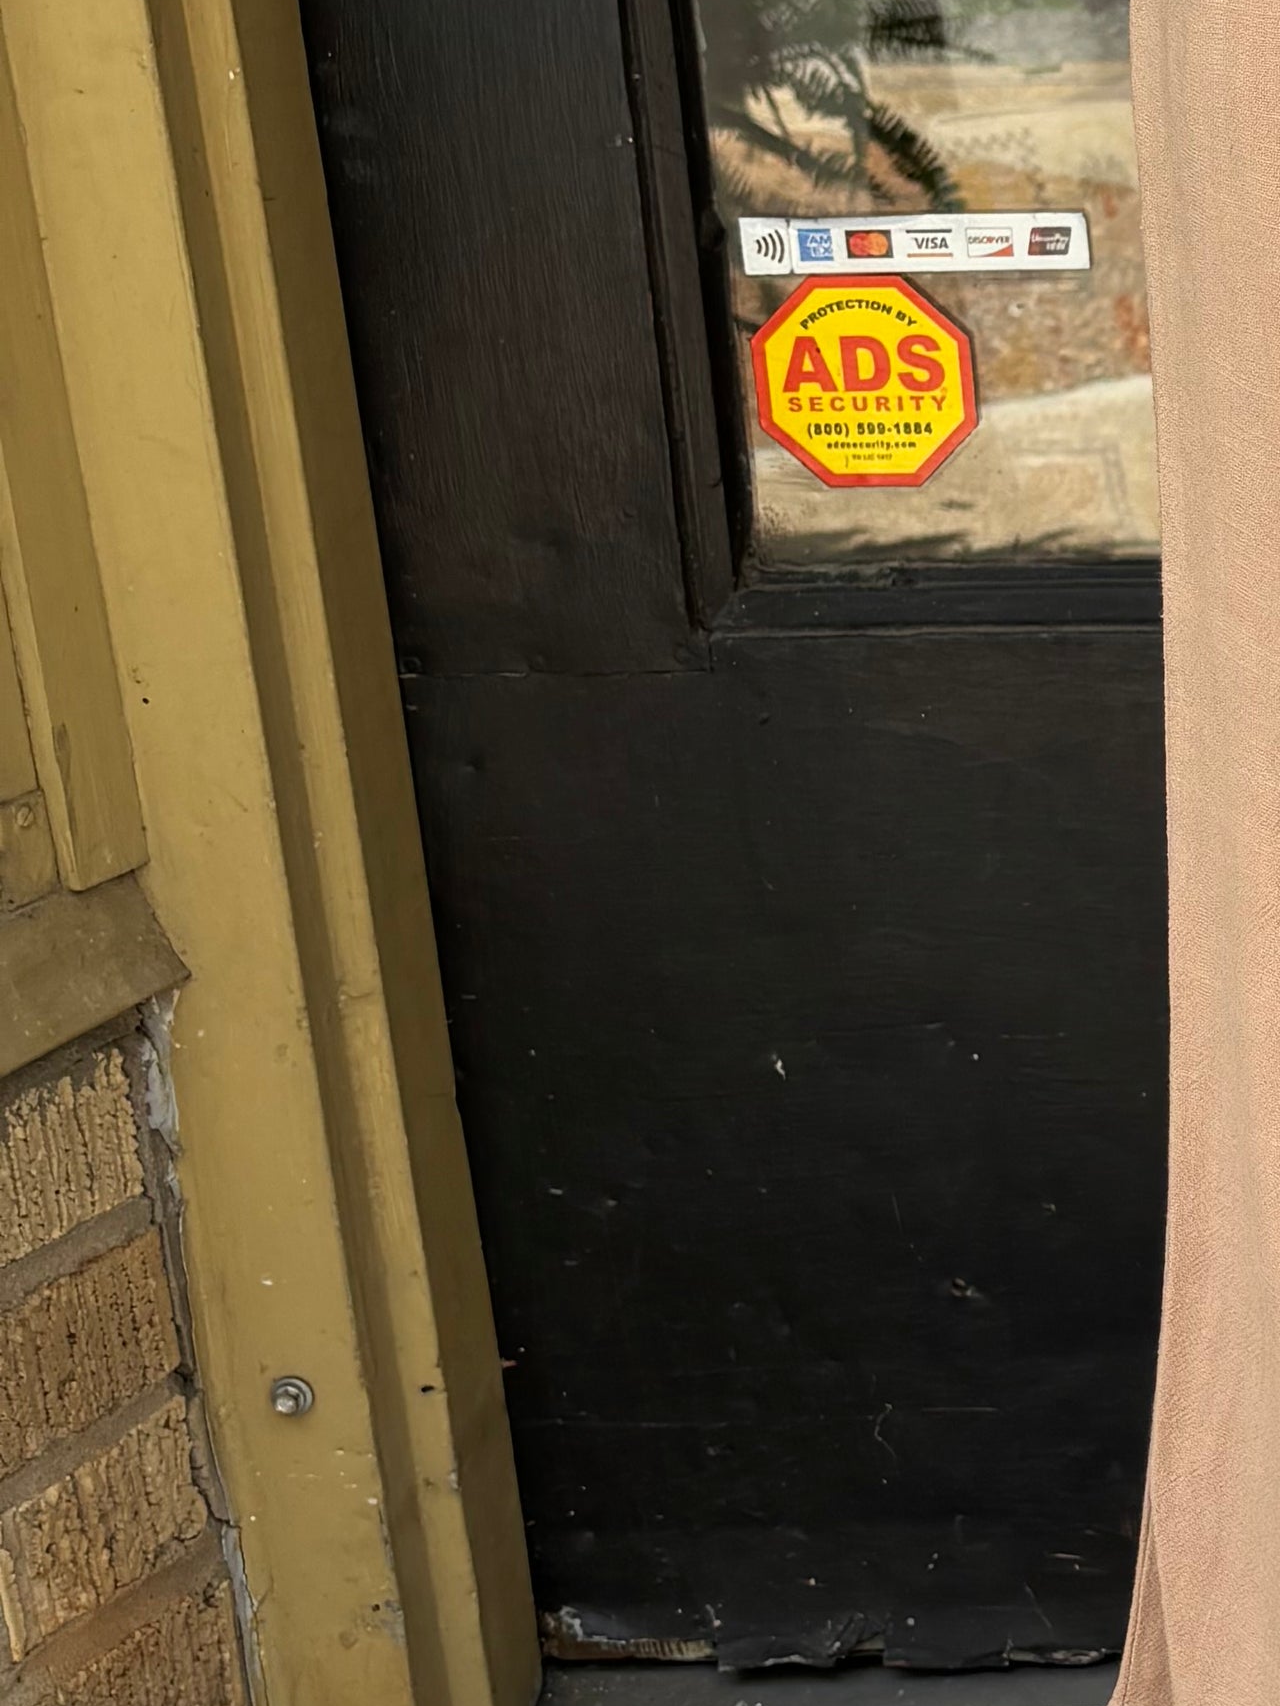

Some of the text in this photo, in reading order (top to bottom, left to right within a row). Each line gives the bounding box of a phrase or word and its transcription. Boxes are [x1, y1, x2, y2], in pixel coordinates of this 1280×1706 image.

[912, 236, 949, 250] VISA
[800, 299, 917, 329] PROTECTION BY
[783, 334, 945, 393] ADS
[788, 395, 946, 412] SECURITY
[807, 423, 849, 439] (800)
